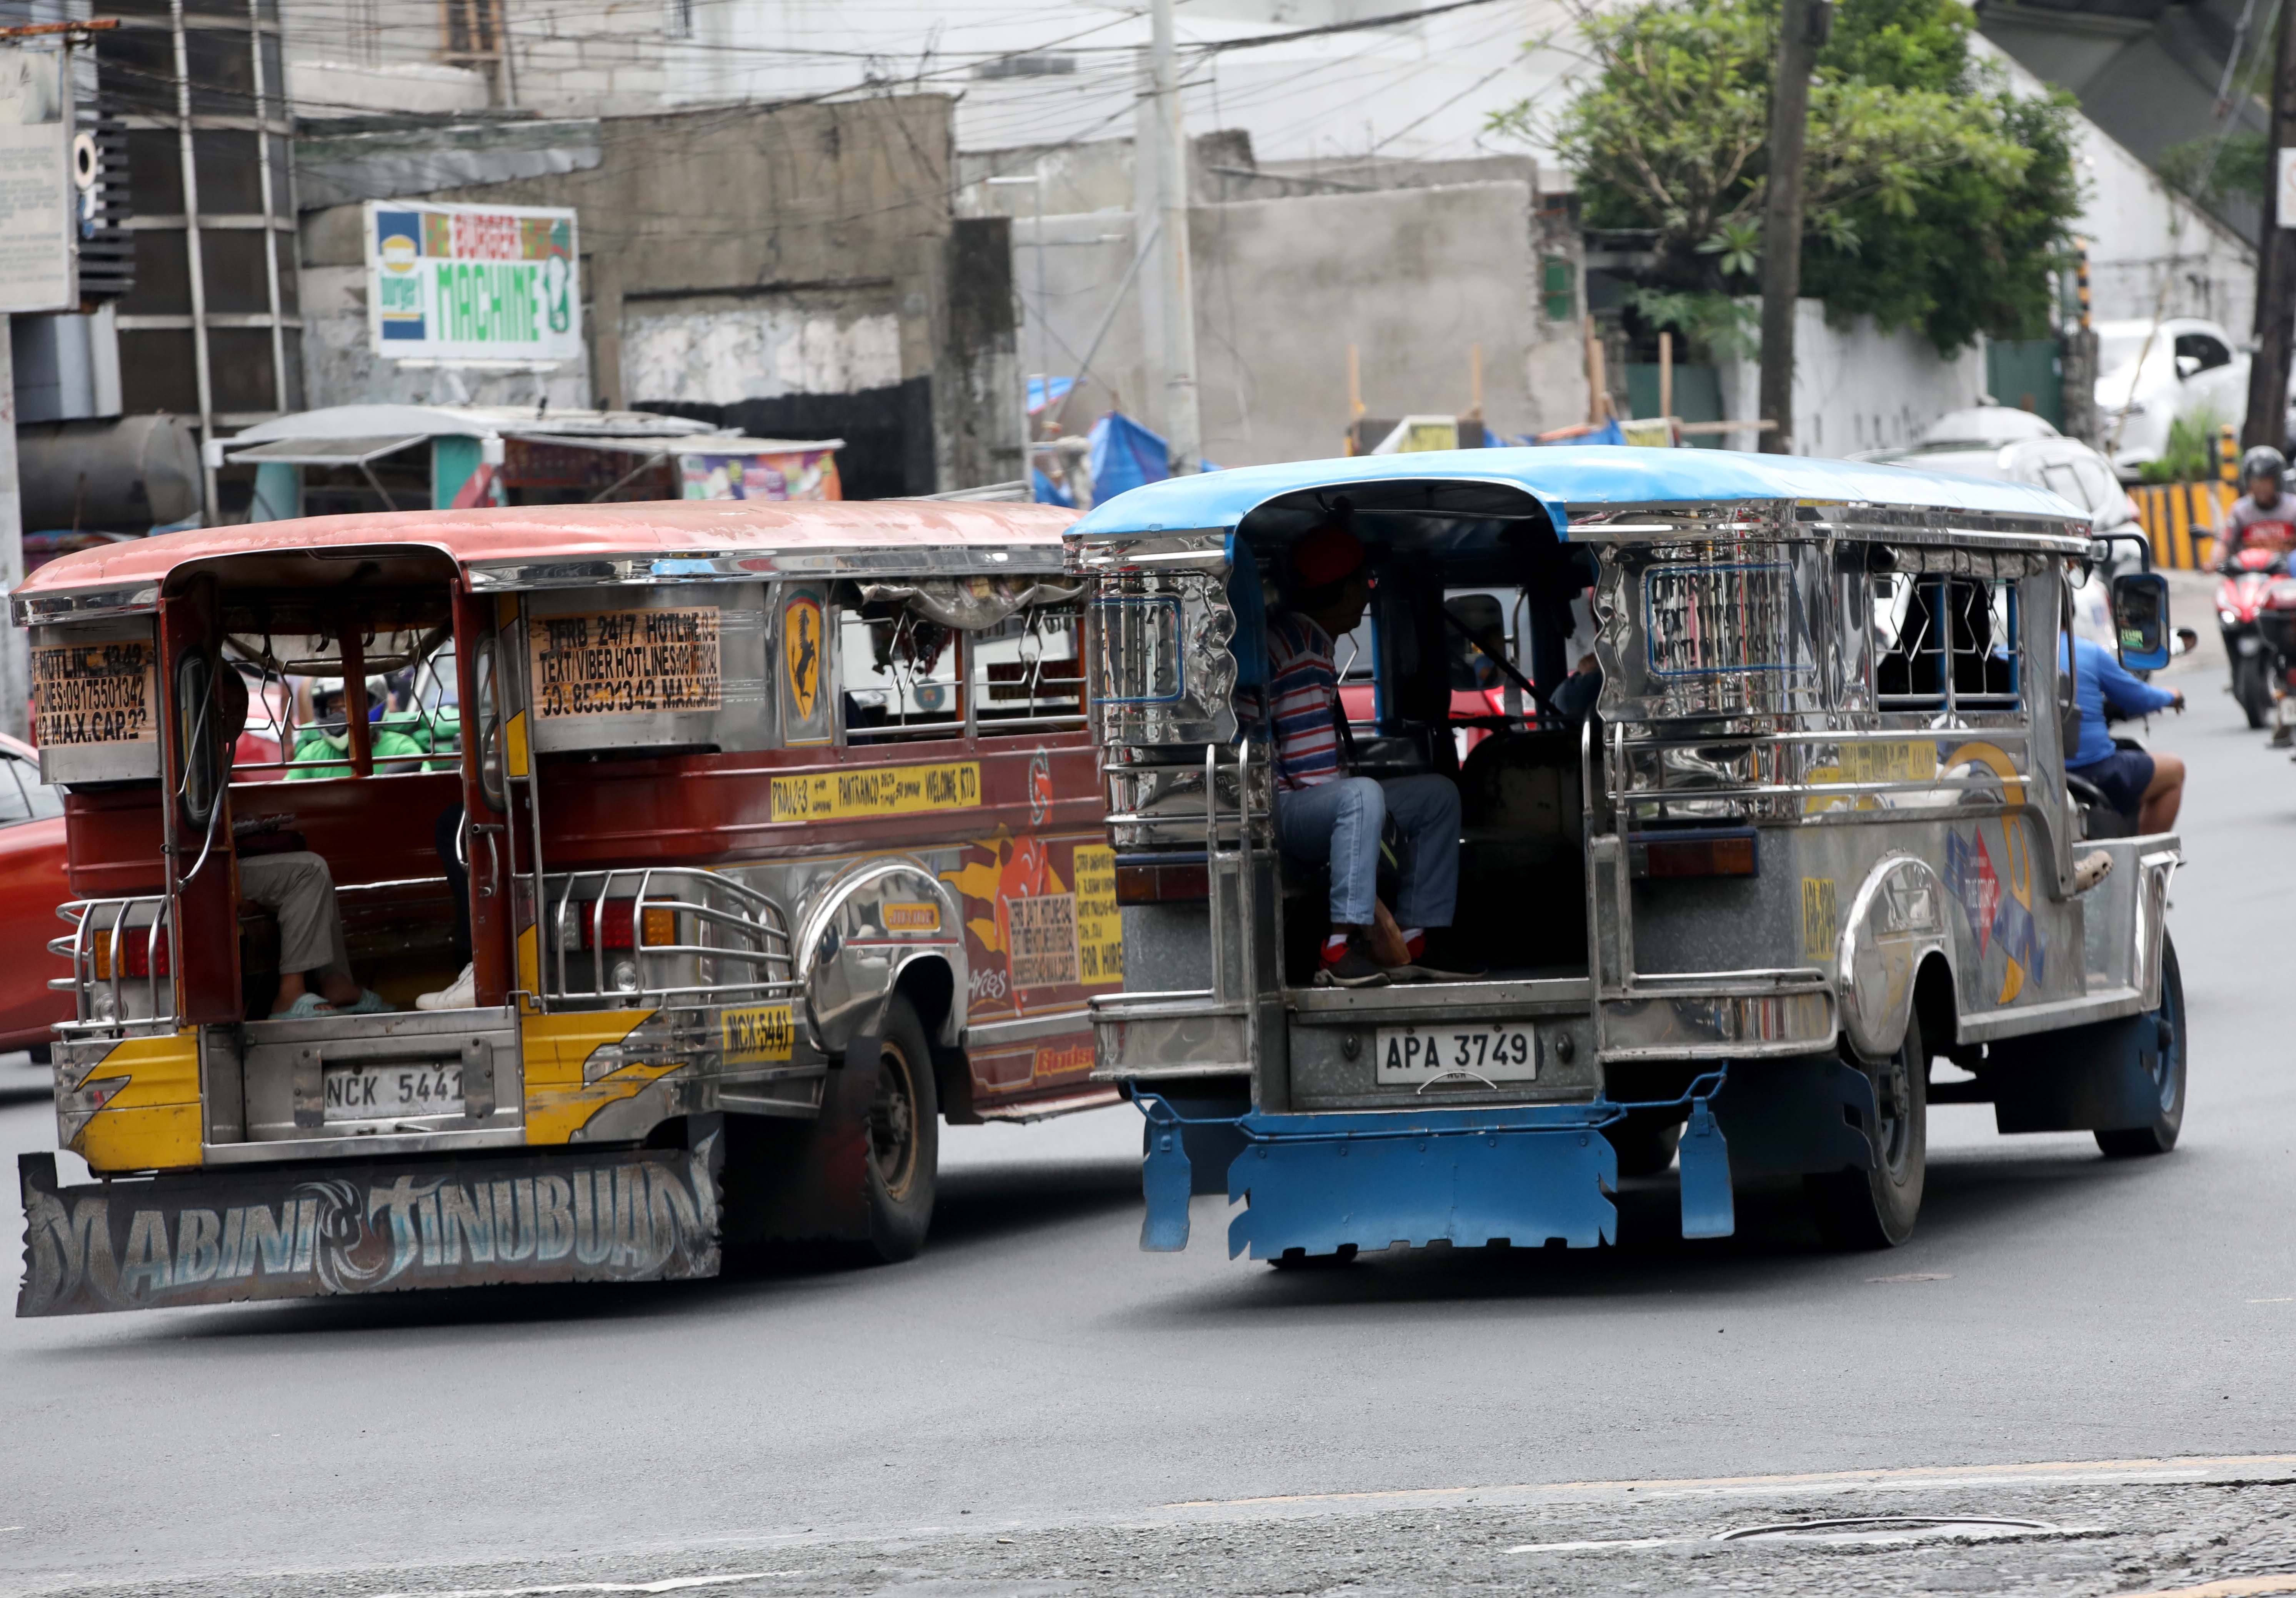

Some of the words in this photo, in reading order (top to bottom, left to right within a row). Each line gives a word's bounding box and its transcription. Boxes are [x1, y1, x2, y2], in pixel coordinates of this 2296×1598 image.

[436, 263, 539, 341] MACHINE
[598, 614, 636, 646] 24/7
[539, 648, 614, 684] TEXT/VIBER
[838, 774, 879, 807] PANTRANCO
[1386, 1037, 1440, 1069] APA
[1454, 1034, 1527, 1066] 3749
[327, 1076, 378, 1107] NCK
[398, 1071, 464, 1103] 5441
[25, 1184, 320, 1307] MABINI
